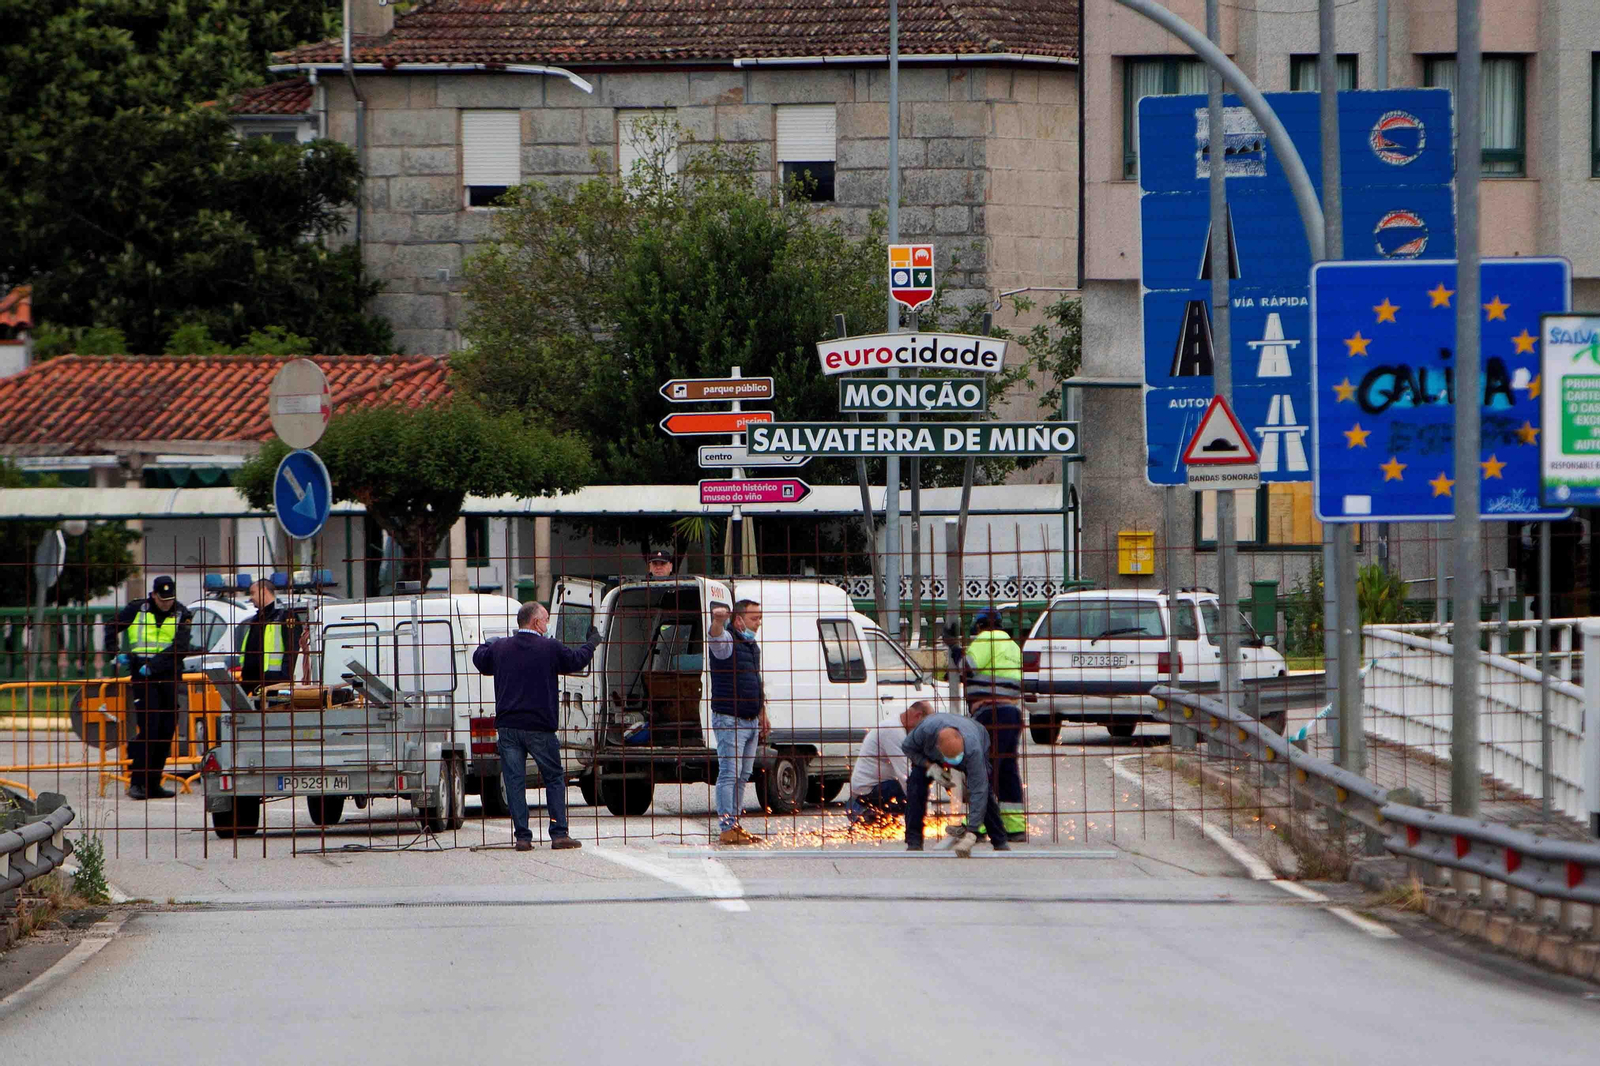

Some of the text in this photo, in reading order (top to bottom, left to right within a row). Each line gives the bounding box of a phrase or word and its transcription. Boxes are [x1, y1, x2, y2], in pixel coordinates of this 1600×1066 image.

[1234, 295, 1309, 307] VÍA RÁPIDA
[825, 337, 998, 369] eurocidade
[703, 384, 768, 395] parque público
[844, 381, 981, 411] MONÇÃO
[752, 425, 1076, 451] SALVATERRA DE MIÑO
[704, 453, 733, 461] centro
[1550, 461, 1593, 469] RESPONSABLE
[1189, 473, 1259, 483] BANDAS SONORAS
[742, 483, 778, 492] histórico
[732, 492, 743, 501] do
[744, 492, 762, 501] viño
[301, 777, 329, 789] 5291
[333, 776, 348, 789] AH
